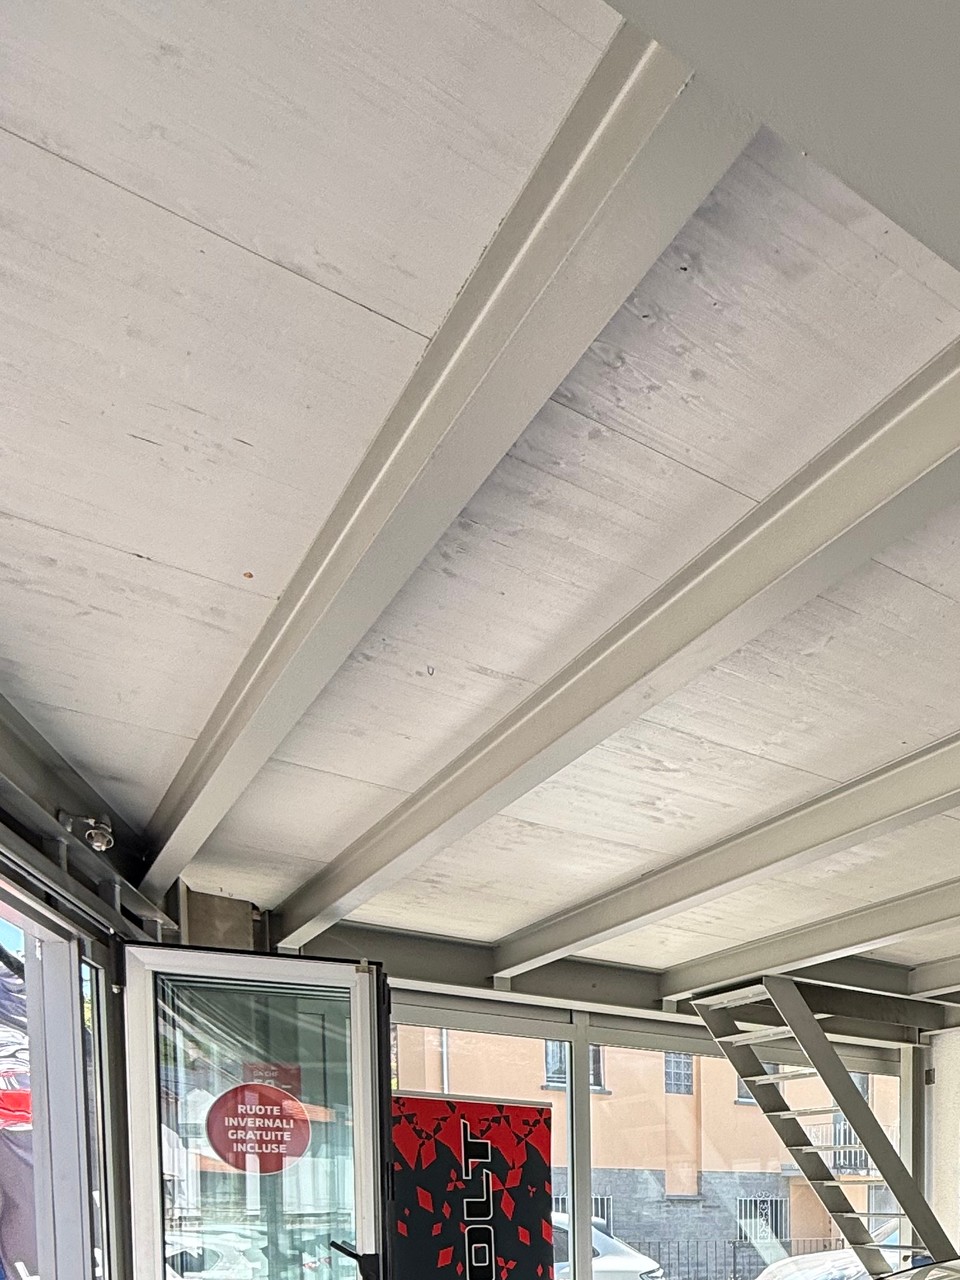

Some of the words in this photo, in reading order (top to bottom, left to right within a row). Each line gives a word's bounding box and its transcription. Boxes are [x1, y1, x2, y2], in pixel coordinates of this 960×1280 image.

[237, 1104, 281, 1115] RUOTE
[224, 1117, 294, 1128] INVERNALI
[228, 1130, 291, 1140] GRATUITE
[233, 1142, 287, 1153] INCLUSE
